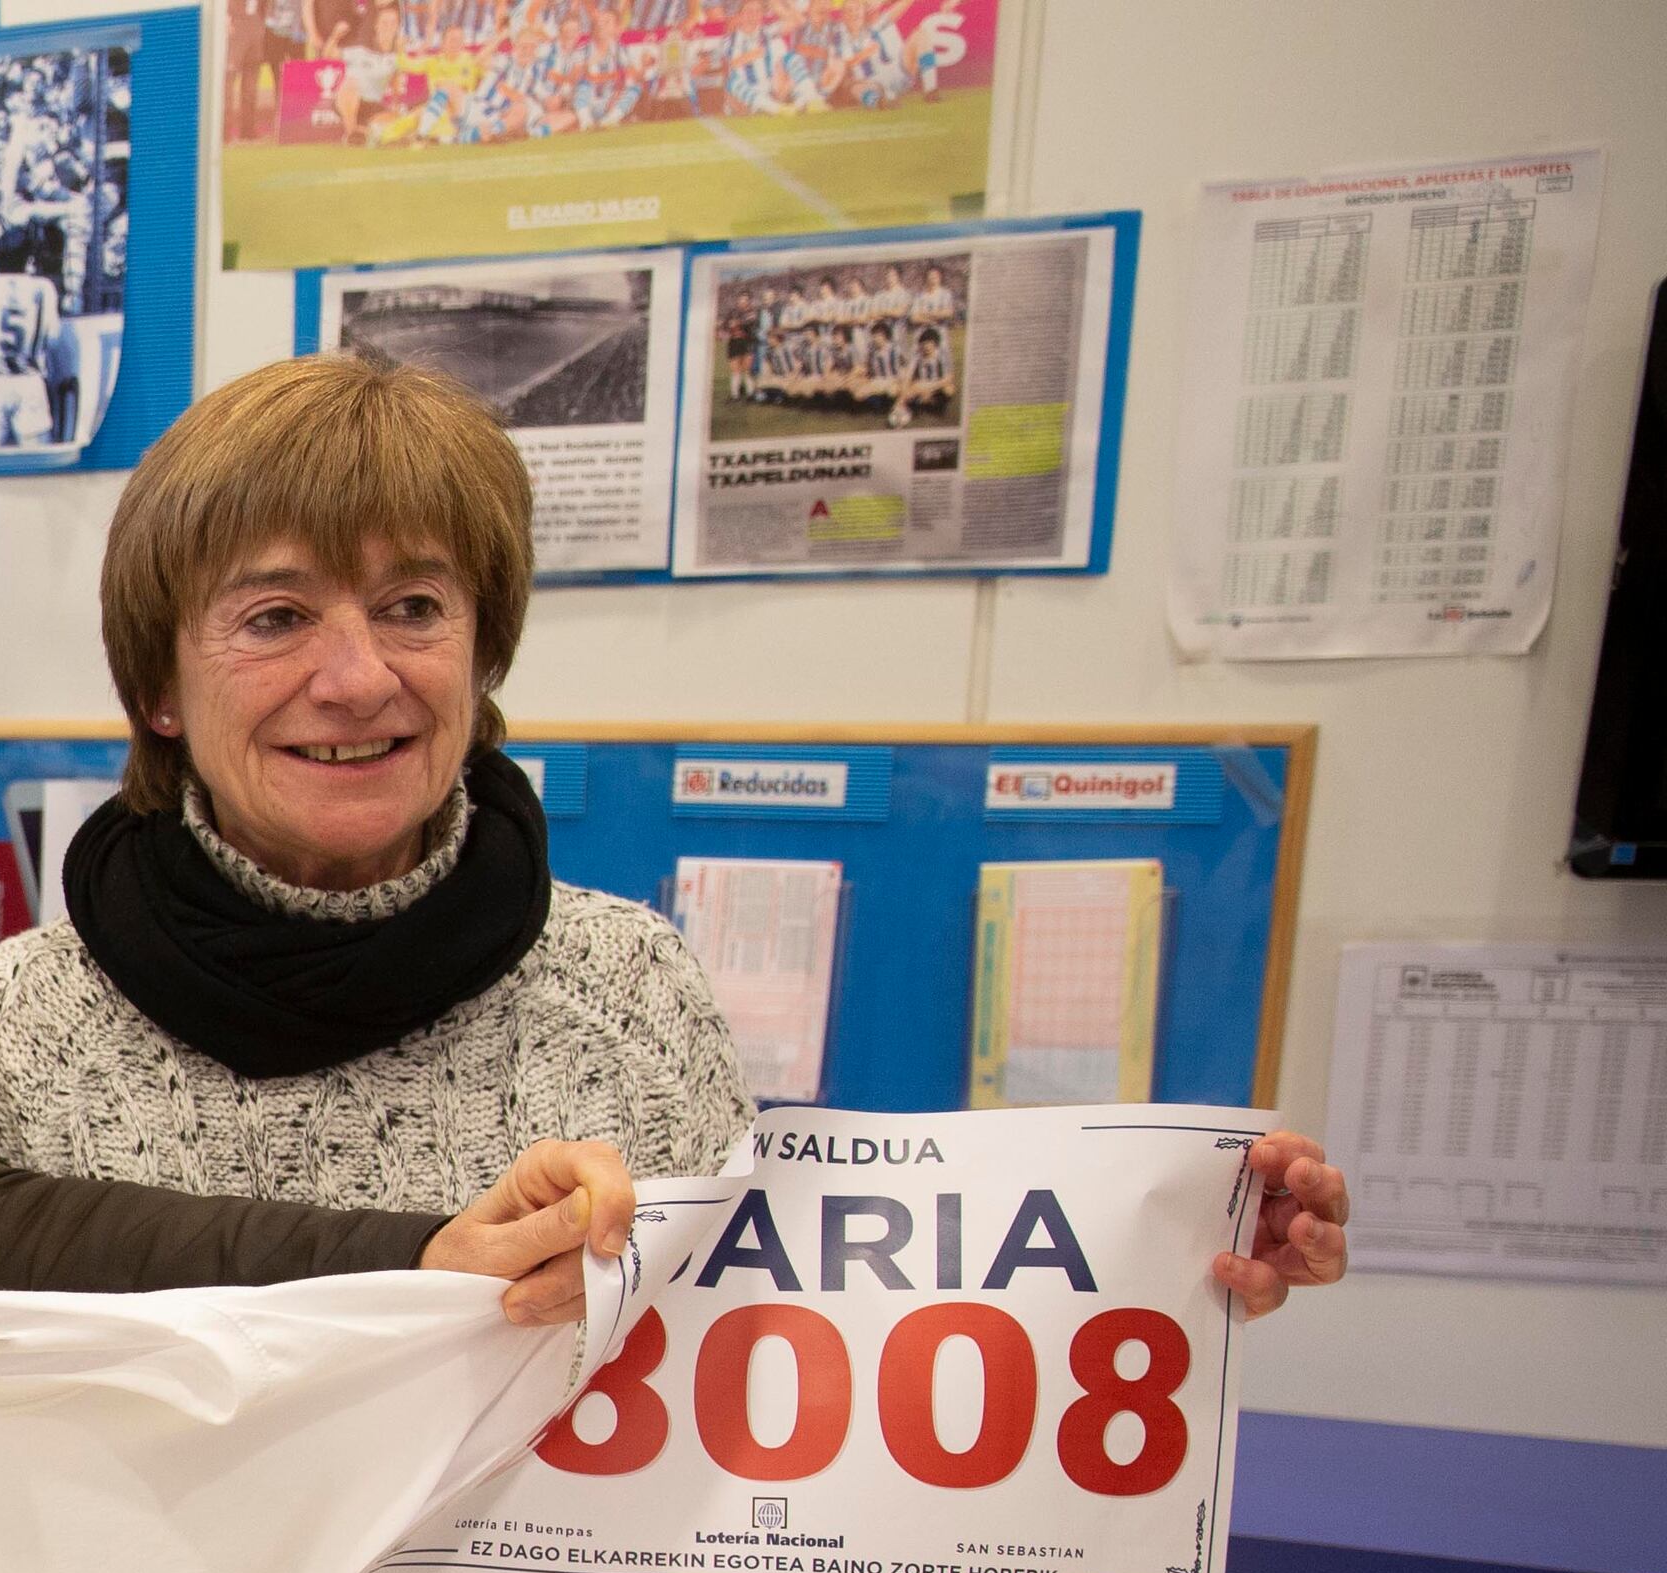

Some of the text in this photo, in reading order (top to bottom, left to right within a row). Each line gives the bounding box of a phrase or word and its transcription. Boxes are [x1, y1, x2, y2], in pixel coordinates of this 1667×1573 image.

[810, 500, 829, 519] A
[719, 770, 829, 796] Reducidas
[995, 773, 1165, 799] El Quinigol
[777, 1131, 946, 1165] SALDUA
[668, 1188, 1100, 1293] ARIA
[532, 1302, 1193, 1497] 8008
[455, 1518, 594, 1539] Lotería El Buenpas
[695, 1530, 845, 1550] Lotería Nacional
[470, 1540, 494, 1557] EZ
[499, 1543, 561, 1563] DAGO
[567, 1548, 705, 1568] ELKARREKIN
[713, 1554, 805, 1573] EGOTEA
[956, 1542, 1085, 1559] SAN SEBASTIAN
